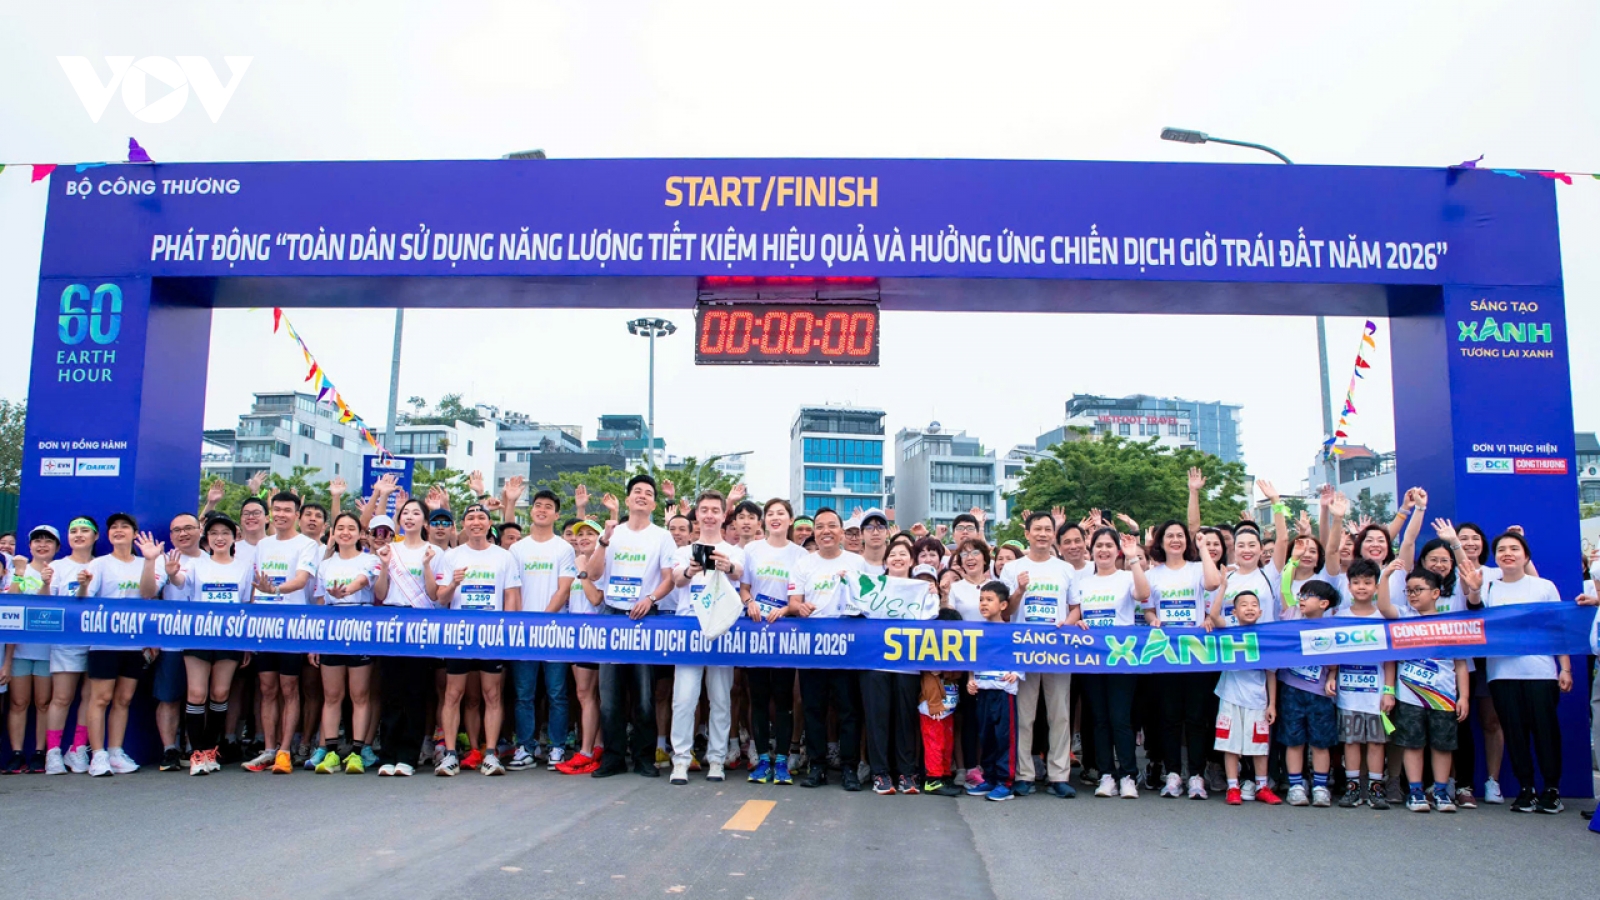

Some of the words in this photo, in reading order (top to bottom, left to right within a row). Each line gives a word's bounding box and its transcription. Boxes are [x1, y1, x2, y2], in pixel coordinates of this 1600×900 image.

[66, 177, 93, 200] BỘ
[98, 176, 156, 195] CÔNG
[162, 177, 241, 195] THƯƠNG
[664, 176, 878, 211] START/FINISH
[151, 227, 209, 261] PHÁT
[211, 226, 271, 268] ĐỘNG
[276, 226, 346, 261] “TOÀN
[349, 226, 396, 261] DÂN
[400, 223, 430, 261] SỬ
[433, 233, 494, 268] DỤNG
[498, 226, 563, 261] NĂNG
[567, 229, 643, 268] LƯỢNG
[648, 220, 697, 261] TIẾT
[701, 226, 757, 269] KIỆM
[762, 226, 815, 269] HIỆU
[820, 223, 870, 268] QUẢ
[873, 227, 906, 262] VÀ
[910, 224, 992, 263] HƯỞNG
[997, 228, 1045, 264] ỨNG
[1050, 223, 1118, 265] CHIẾN
[1124, 237, 1175, 273] DỊCH
[1180, 231, 1218, 267] GIỜ
[1221, 232, 1274, 267] TRÁI
[1279, 226, 1324, 268] ĐẤT
[1329, 234, 1381, 269] NĂM
[1385, 241, 1448, 270] 2026”
[58, 283, 123, 345] 60
[1470, 299, 1508, 311] SÁNG
[1511, 302, 1538, 314] TẠO
[700, 311, 875, 355] 00:00:00
[1457, 317, 1552, 343] XANH
[56, 350, 116, 365] EARTH
[1460, 348, 1499, 357] TƯƠNG
[1502, 349, 1519, 358] LAI
[1522, 349, 1553, 358] XANH
[58, 368, 113, 382] HOUR
[1098, 416, 1142, 424] VIETFOOT
[1146, 416, 1177, 425] TRAVEL
[38, 441, 59, 450] ĐƠN
[61, 441, 70, 451] VỊ
[101, 440, 127, 450] HÀNH
[1473, 443, 1494, 452] ĐƠN
[1496, 444, 1506, 454] VỊ
[1509, 444, 1534, 455] THỰC
[1536, 443, 1557, 455] HIỆN
[1485, 460, 1509, 469] ĐCK
[207, 592, 232, 600] 3.453
[613, 585, 636, 594] 3.663
[2, 612, 20, 620] EVN
[1027, 605, 1055, 614] 28.403
[1166, 609, 1191, 617] 3.668
[80, 604, 107, 632] GIẢI
[111, 610, 146, 639] CHẠY
[194, 611, 223, 636] DÂN
[225, 609, 247, 637] SỬ
[247, 616, 284, 643] DỤNG
[286, 614, 325, 640] NĂNG
[328, 618, 372, 646] LƯỢNG
[376, 615, 404, 643] TIẾT
[405, 618, 441, 649] KIỆM
[443, 619, 474, 650] HIỆU
[477, 618, 505, 647] QUẢ
[509, 621, 525, 647] VÀ
[529, 619, 575, 649] HƯỞNG
[579, 623, 606, 650] ỨNG
[610, 622, 651, 651] CHIẾN
[654, 629, 686, 657] DỊCH
[717, 626, 745, 654] TRÁI
[749, 624, 776, 654] ĐẤT
[780, 627, 811, 655] NĂM
[1335, 629, 1378, 645] ĐCK
[883, 627, 984, 662] START
[1012, 629, 1057, 645] SÁNG
[1061, 633, 1094, 649] TẠO
[1105, 629, 1260, 666] XANH
[1013, 649, 1072, 665] TƯƠNG
[1075, 653, 1100, 666] LAI
[1343, 674, 1376, 683] 21.560
[1403, 663, 1435, 680] 21.657
